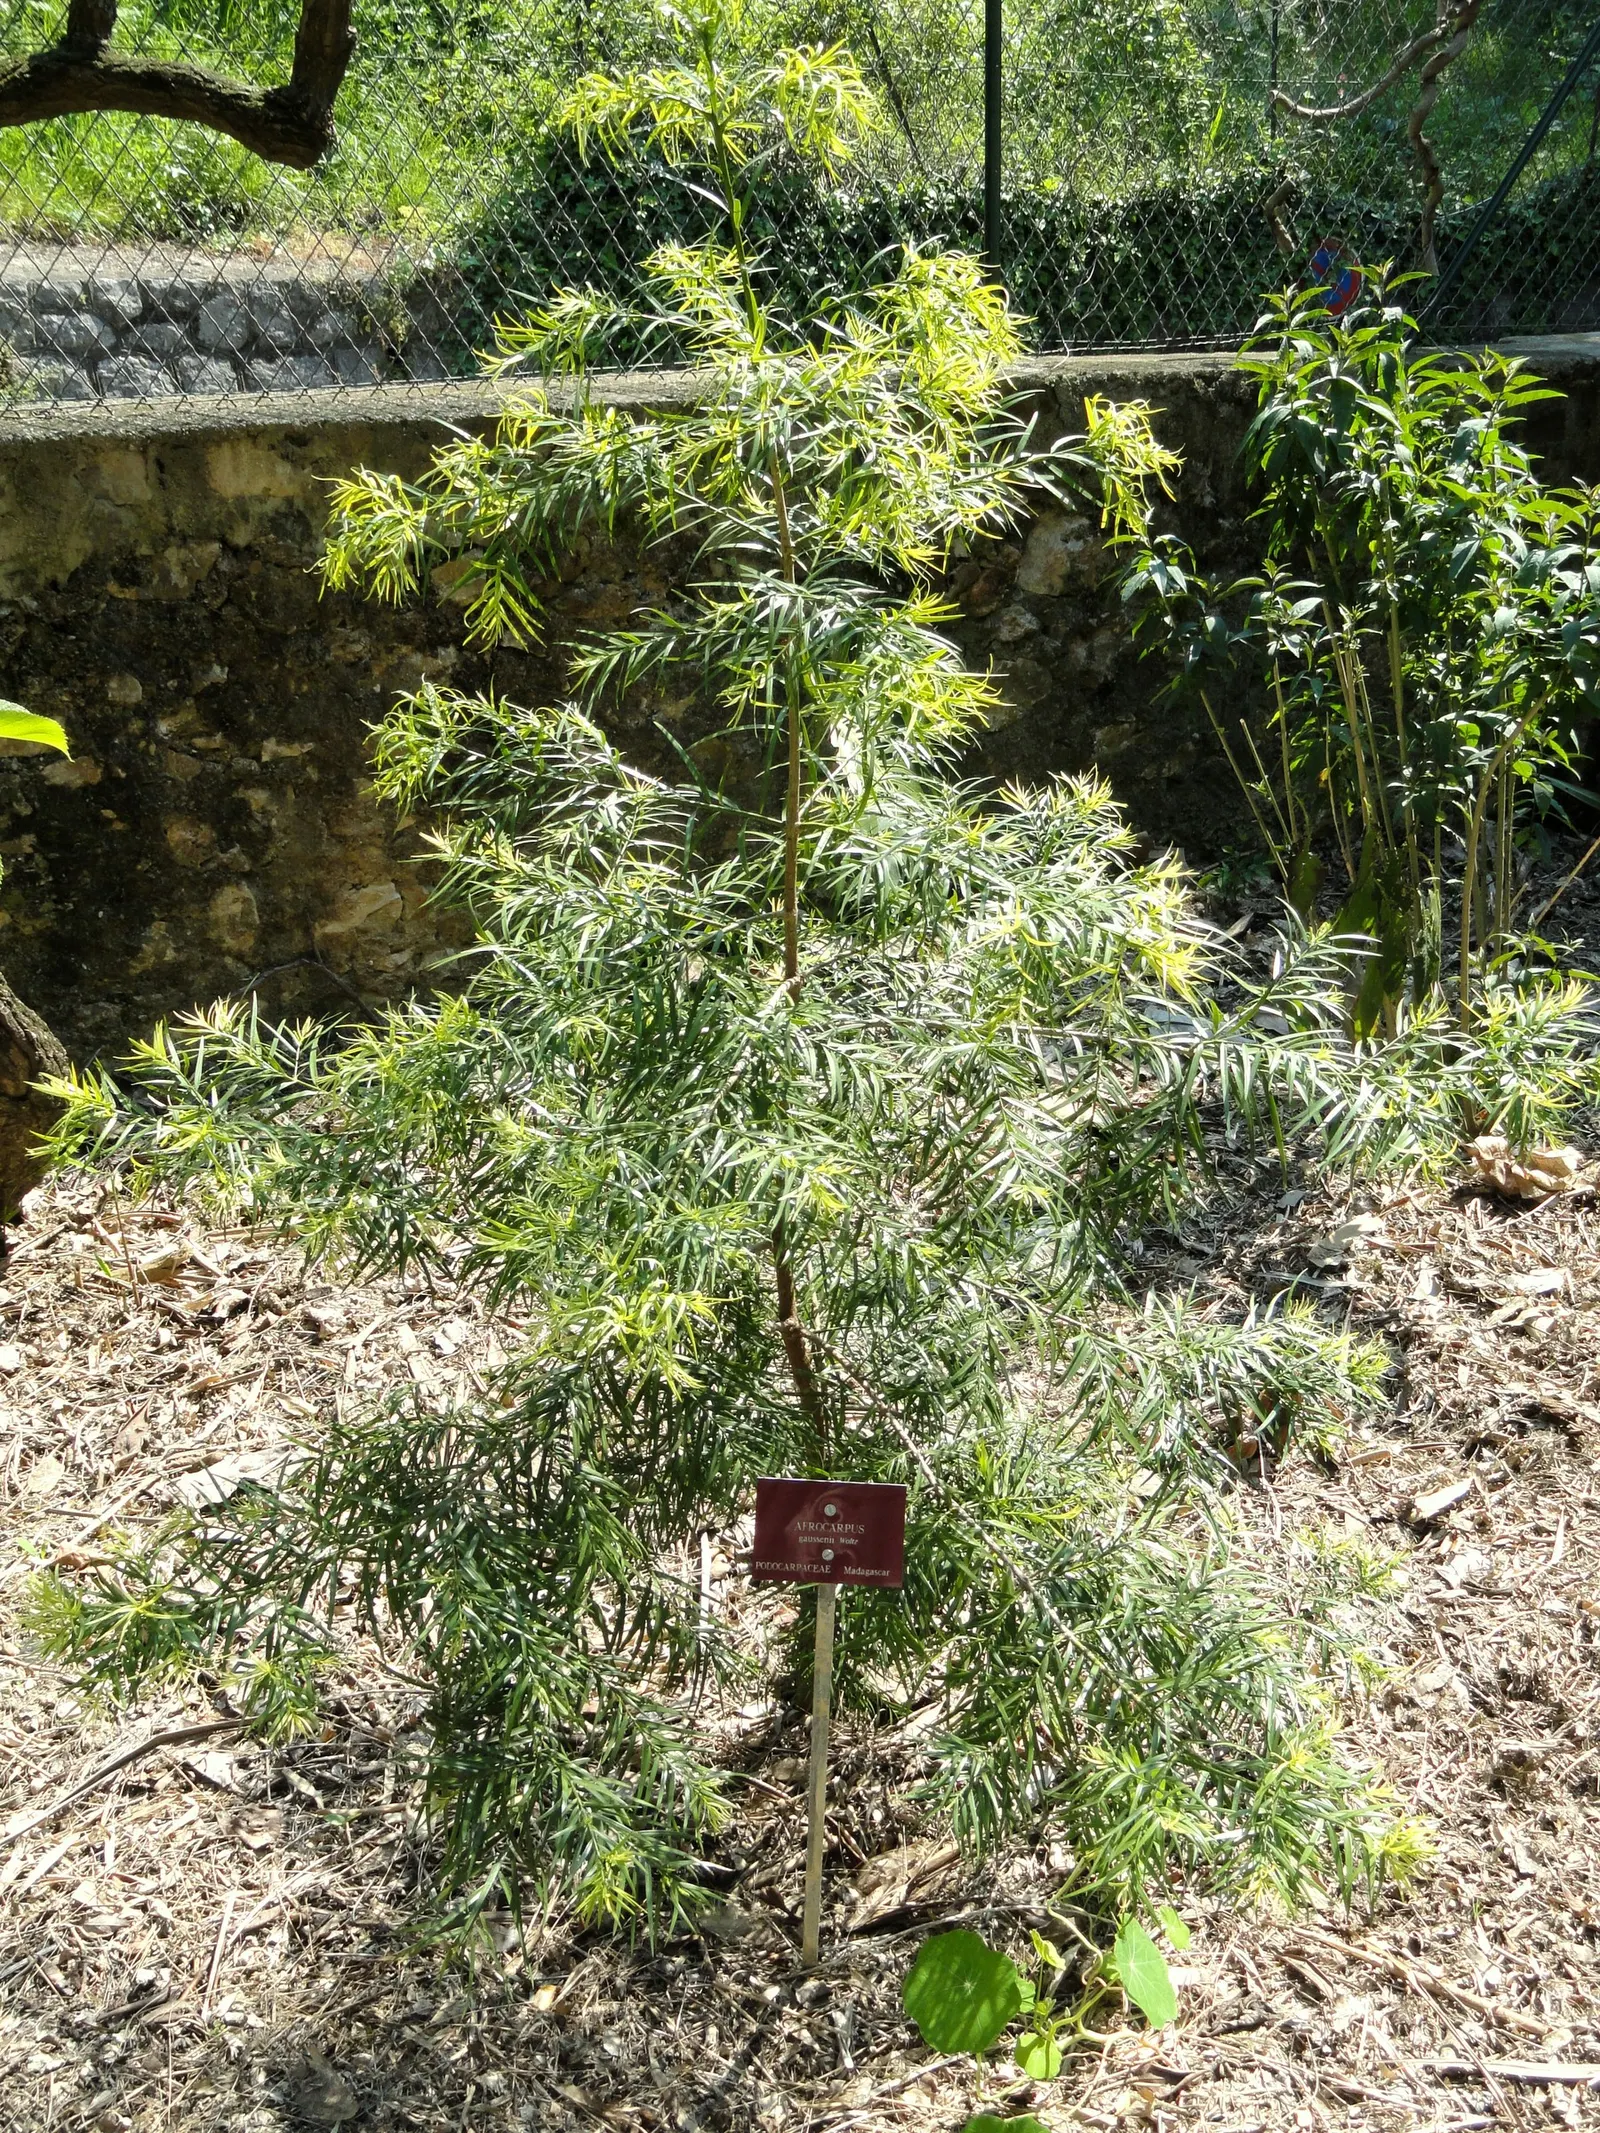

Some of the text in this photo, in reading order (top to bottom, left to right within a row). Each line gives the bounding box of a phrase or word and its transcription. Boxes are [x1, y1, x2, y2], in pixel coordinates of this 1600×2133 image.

[794, 1521, 865, 1534] AFROCARPUS
[755, 1561, 891, 1577] PODOCARPACEAE Madagascar
